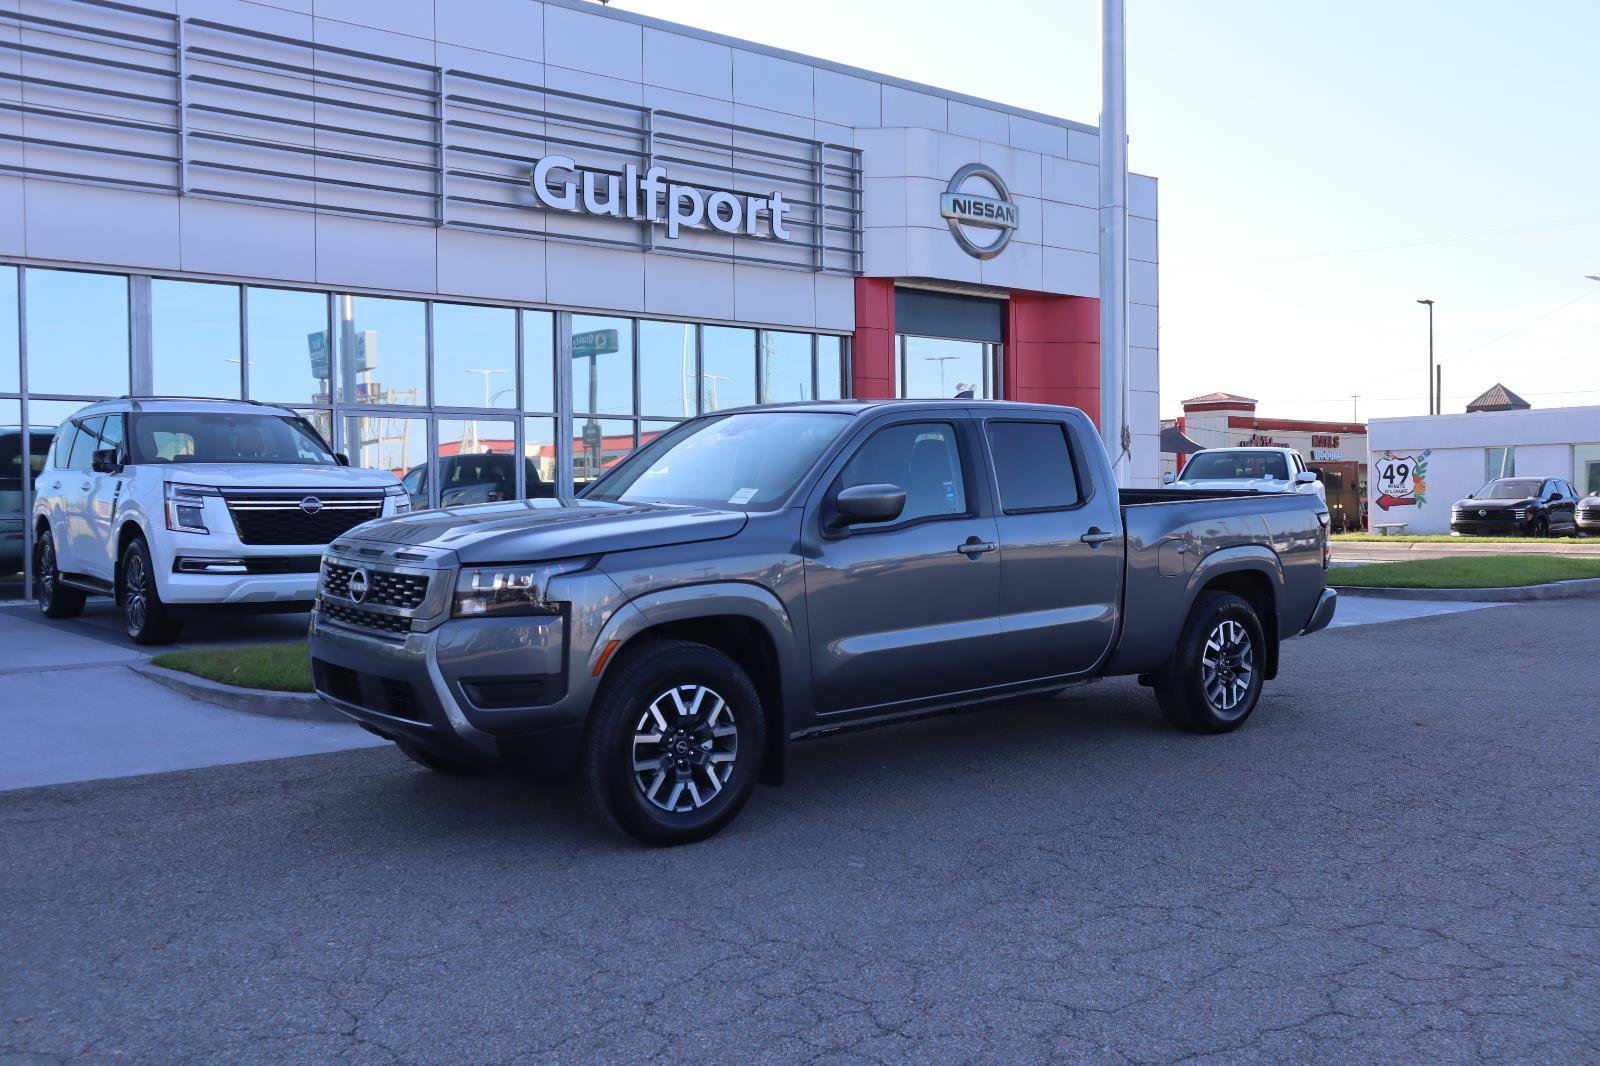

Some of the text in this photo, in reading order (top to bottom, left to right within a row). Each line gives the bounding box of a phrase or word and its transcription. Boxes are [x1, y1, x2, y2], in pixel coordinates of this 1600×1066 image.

[531, 155, 791, 239] Gulfport
[952, 198, 1015, 223] NISSAN
[1383, 464, 1409, 484] 49
